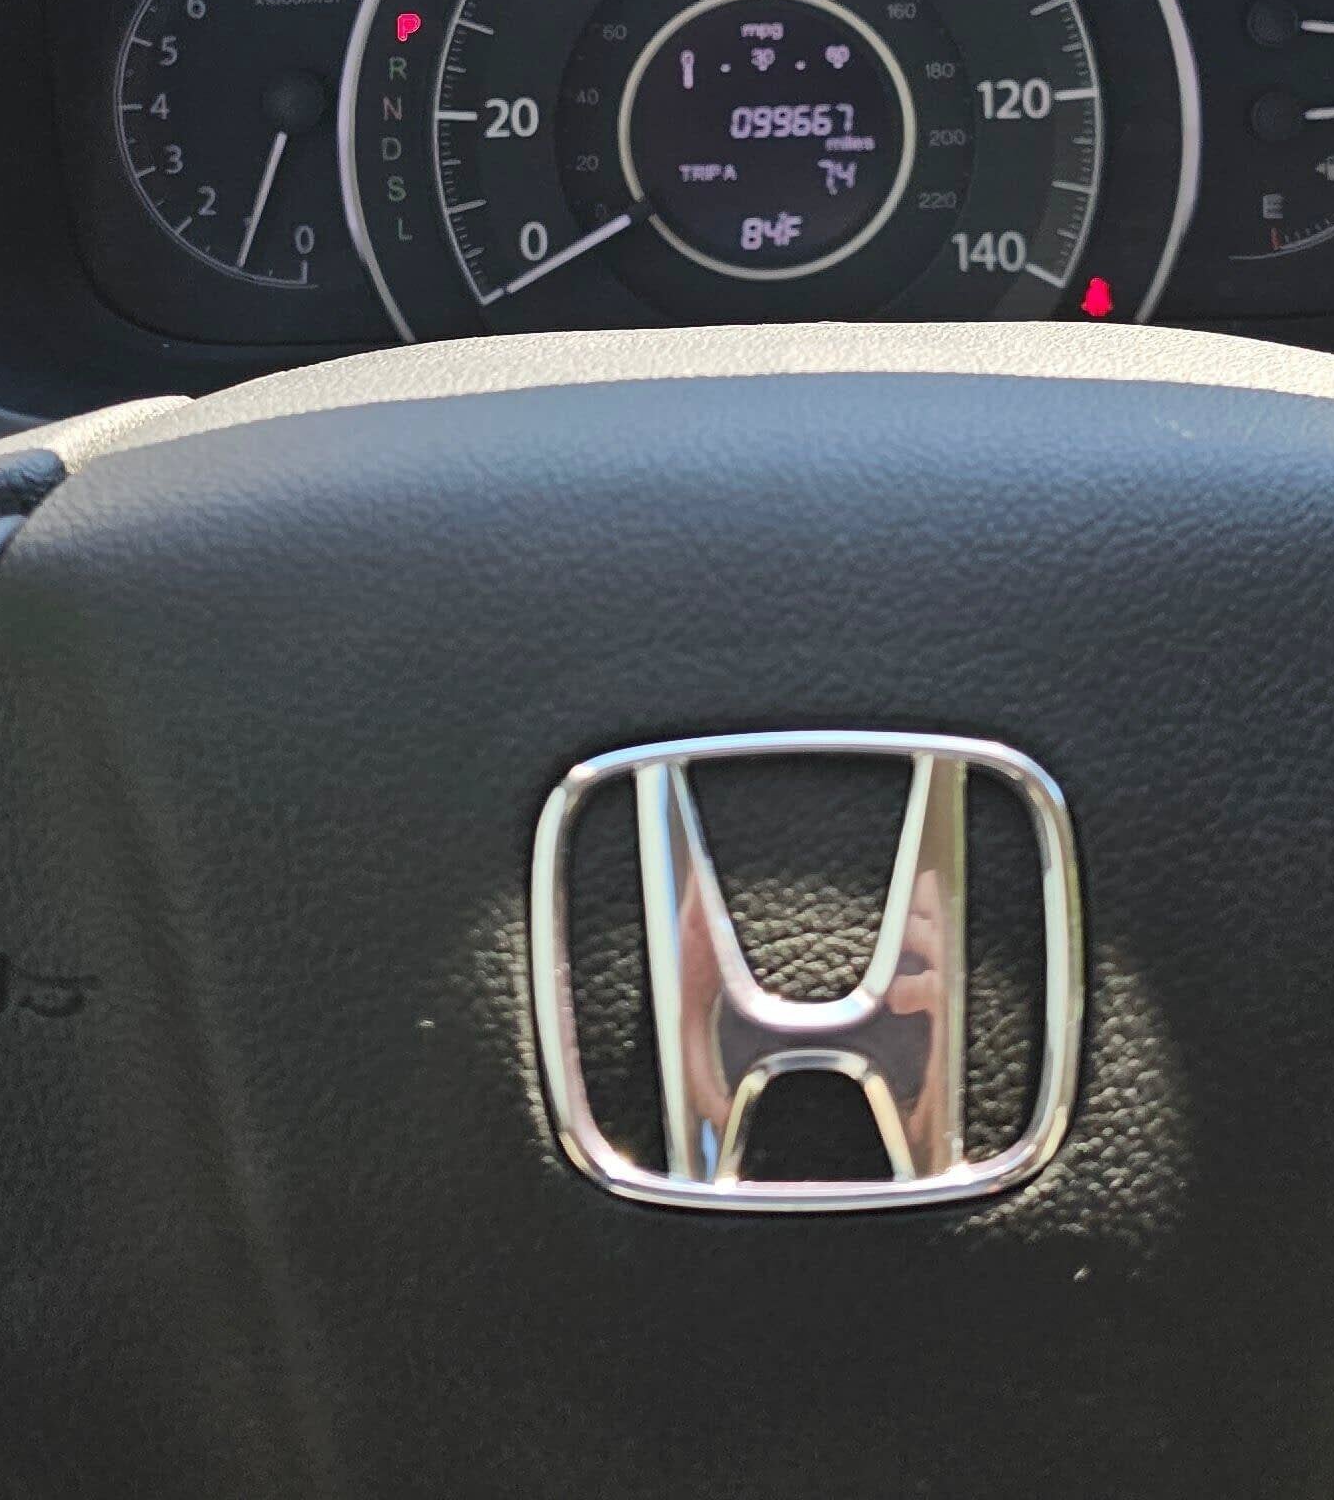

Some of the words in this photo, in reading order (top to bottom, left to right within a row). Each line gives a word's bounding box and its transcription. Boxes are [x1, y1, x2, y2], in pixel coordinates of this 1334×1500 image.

[886, 2, 917, 20] 160
[395, 12, 423, 42] P
[740, 22, 784, 41] mpg
[160, 34, 178, 66] 5
[388, 56, 407, 81] R
[924, 62, 956, 80] 180
[149, 93, 170, 120] 4
[381, 98, 403, 121] N
[575, 89, 600, 106] 40
[977, 79, 1051, 120] 120
[484, 98, 539, 139] 20
[730, 102, 855, 139] 099667
[381, 137, 402, 162] D
[929, 129, 966, 147] 200
[165, 144, 184, 175] 3
[574, 154, 600, 172] 20
[679, 164, 721, 183] TRIP
[386, 175, 407, 201] S
[918, 191, 957, 210] 220
[197, 185, 217, 217] 2
[294, 224, 316, 255] 0
[398, 219, 414, 242] L
[520, 222, 549, 262] 0
[951, 231, 1027, 274] 140
